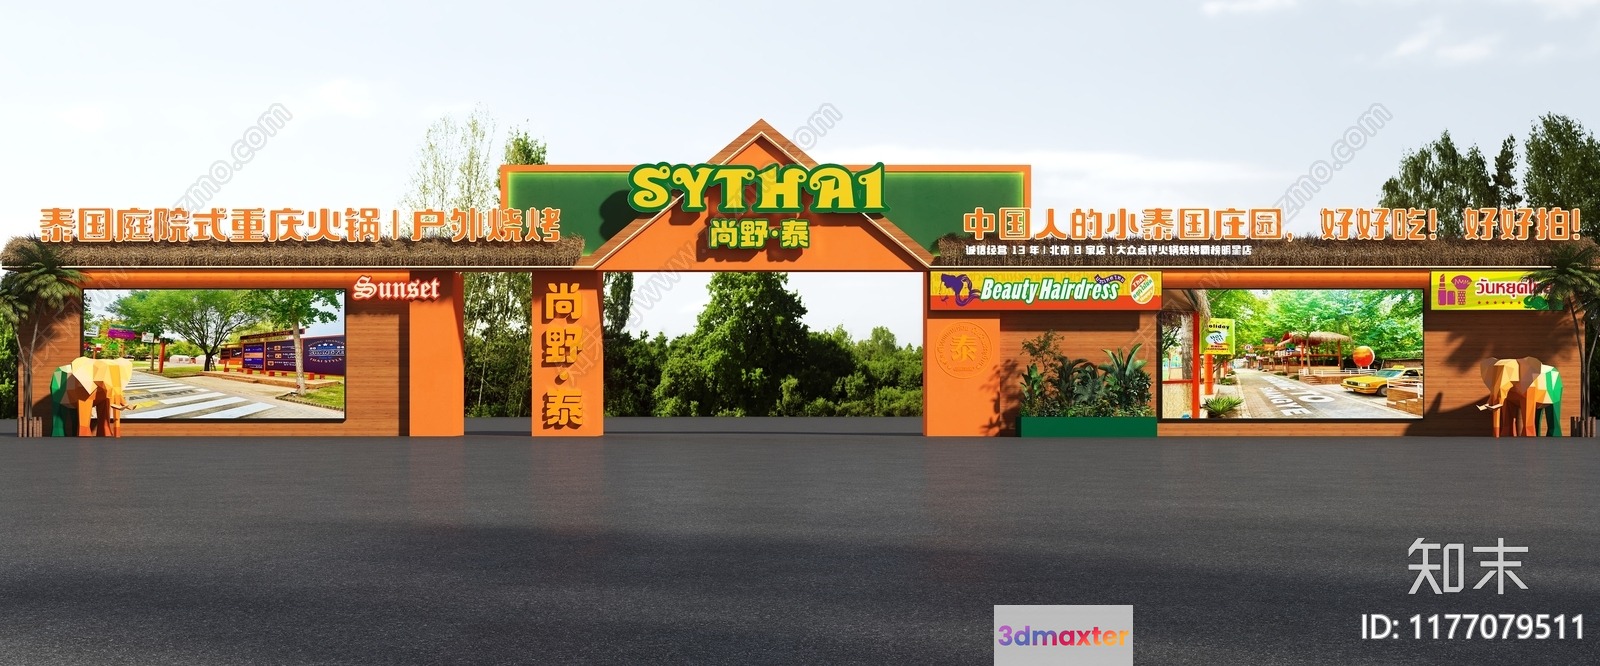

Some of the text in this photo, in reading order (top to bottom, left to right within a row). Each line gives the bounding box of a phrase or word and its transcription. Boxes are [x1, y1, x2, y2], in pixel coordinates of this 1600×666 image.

[1012, 245, 1026, 256] 13
[1029, 245, 1040, 256] 年
[1050, 245, 1070, 256] 北京
[352, 276, 441, 302] Sunset
[981, 277, 1037, 304] Beauty
[1039, 278, 1119, 301] Hairdress
[950, 333, 977, 363] 泰
